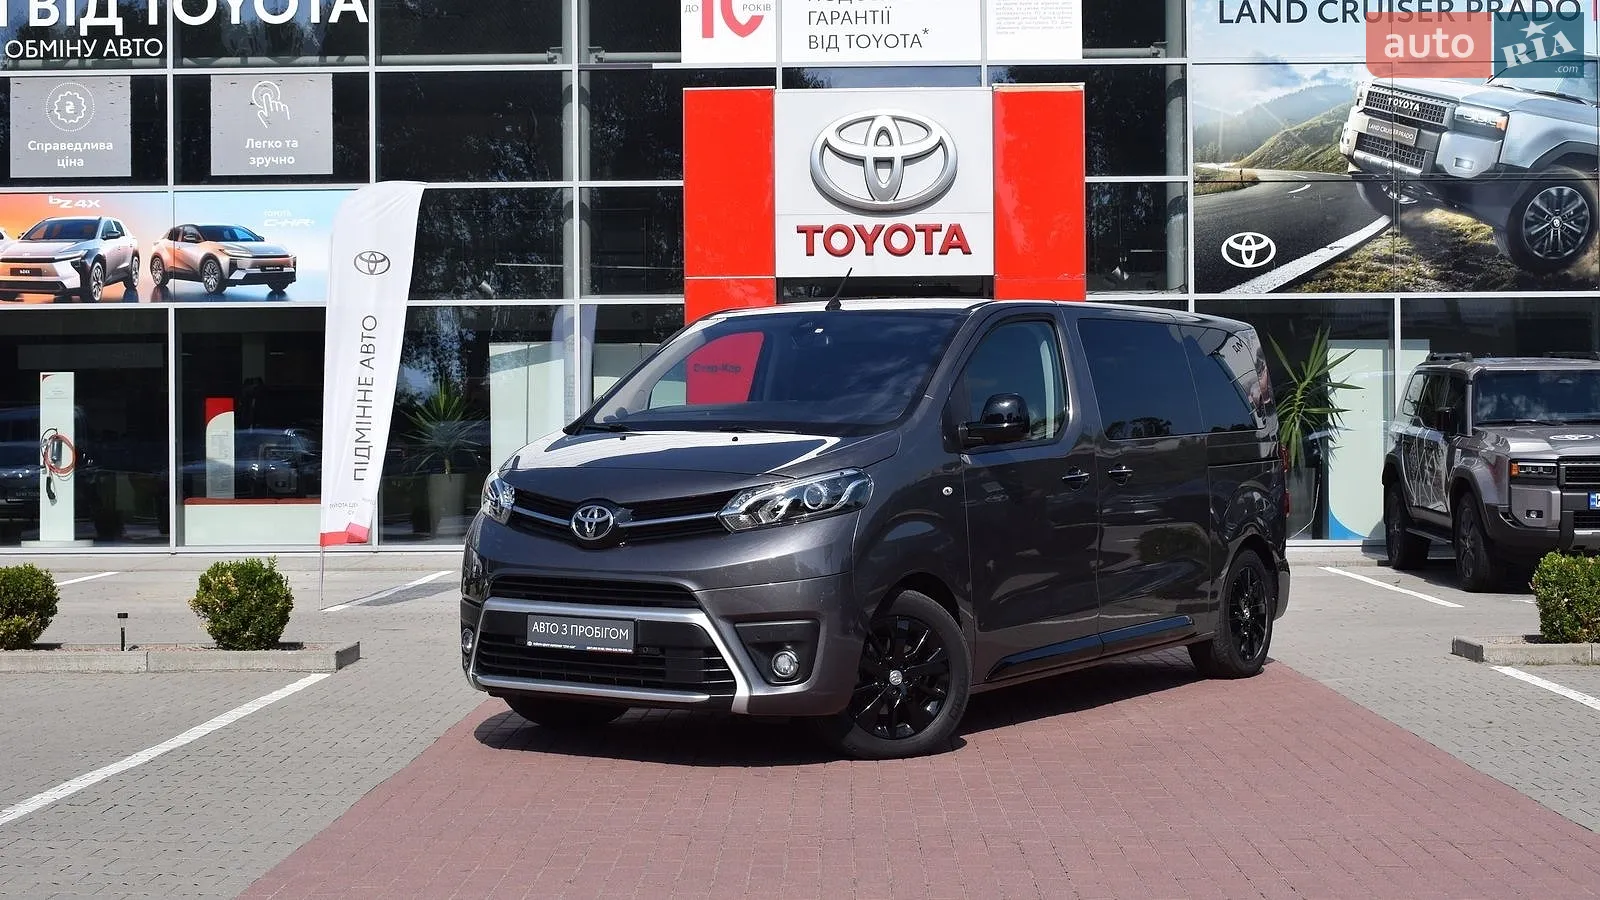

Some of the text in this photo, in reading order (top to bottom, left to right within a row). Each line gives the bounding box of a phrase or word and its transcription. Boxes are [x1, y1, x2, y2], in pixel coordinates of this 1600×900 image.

[685, 3, 772, 13] ДО РОКІВ
[808, 6, 892, 26] ГАРАНТІЇ
[1219, 0, 1308, 24] LAND
[1318, 0, 1455, 24] CRUISER
[1467, 0, 1581, 22] PRADO
[5, 38, 164, 59] ОБМІНУ АВТО
[808, 34, 840, 52] ВІД
[1388, 98, 1420, 111] TOYOTA
[27, 140, 114, 153] Справедлива
[245, 138, 299, 149] Легко та
[57, 155, 85, 169] ціна
[249, 156, 296, 167] зручно
[796, 223, 973, 258] TOYOTA
[359, 315, 378, 371] АВТО
[353, 375, 375, 482] ПІДМІННЕ
[532, 621, 629, 641] АВТО З ПРОБІГОМ
